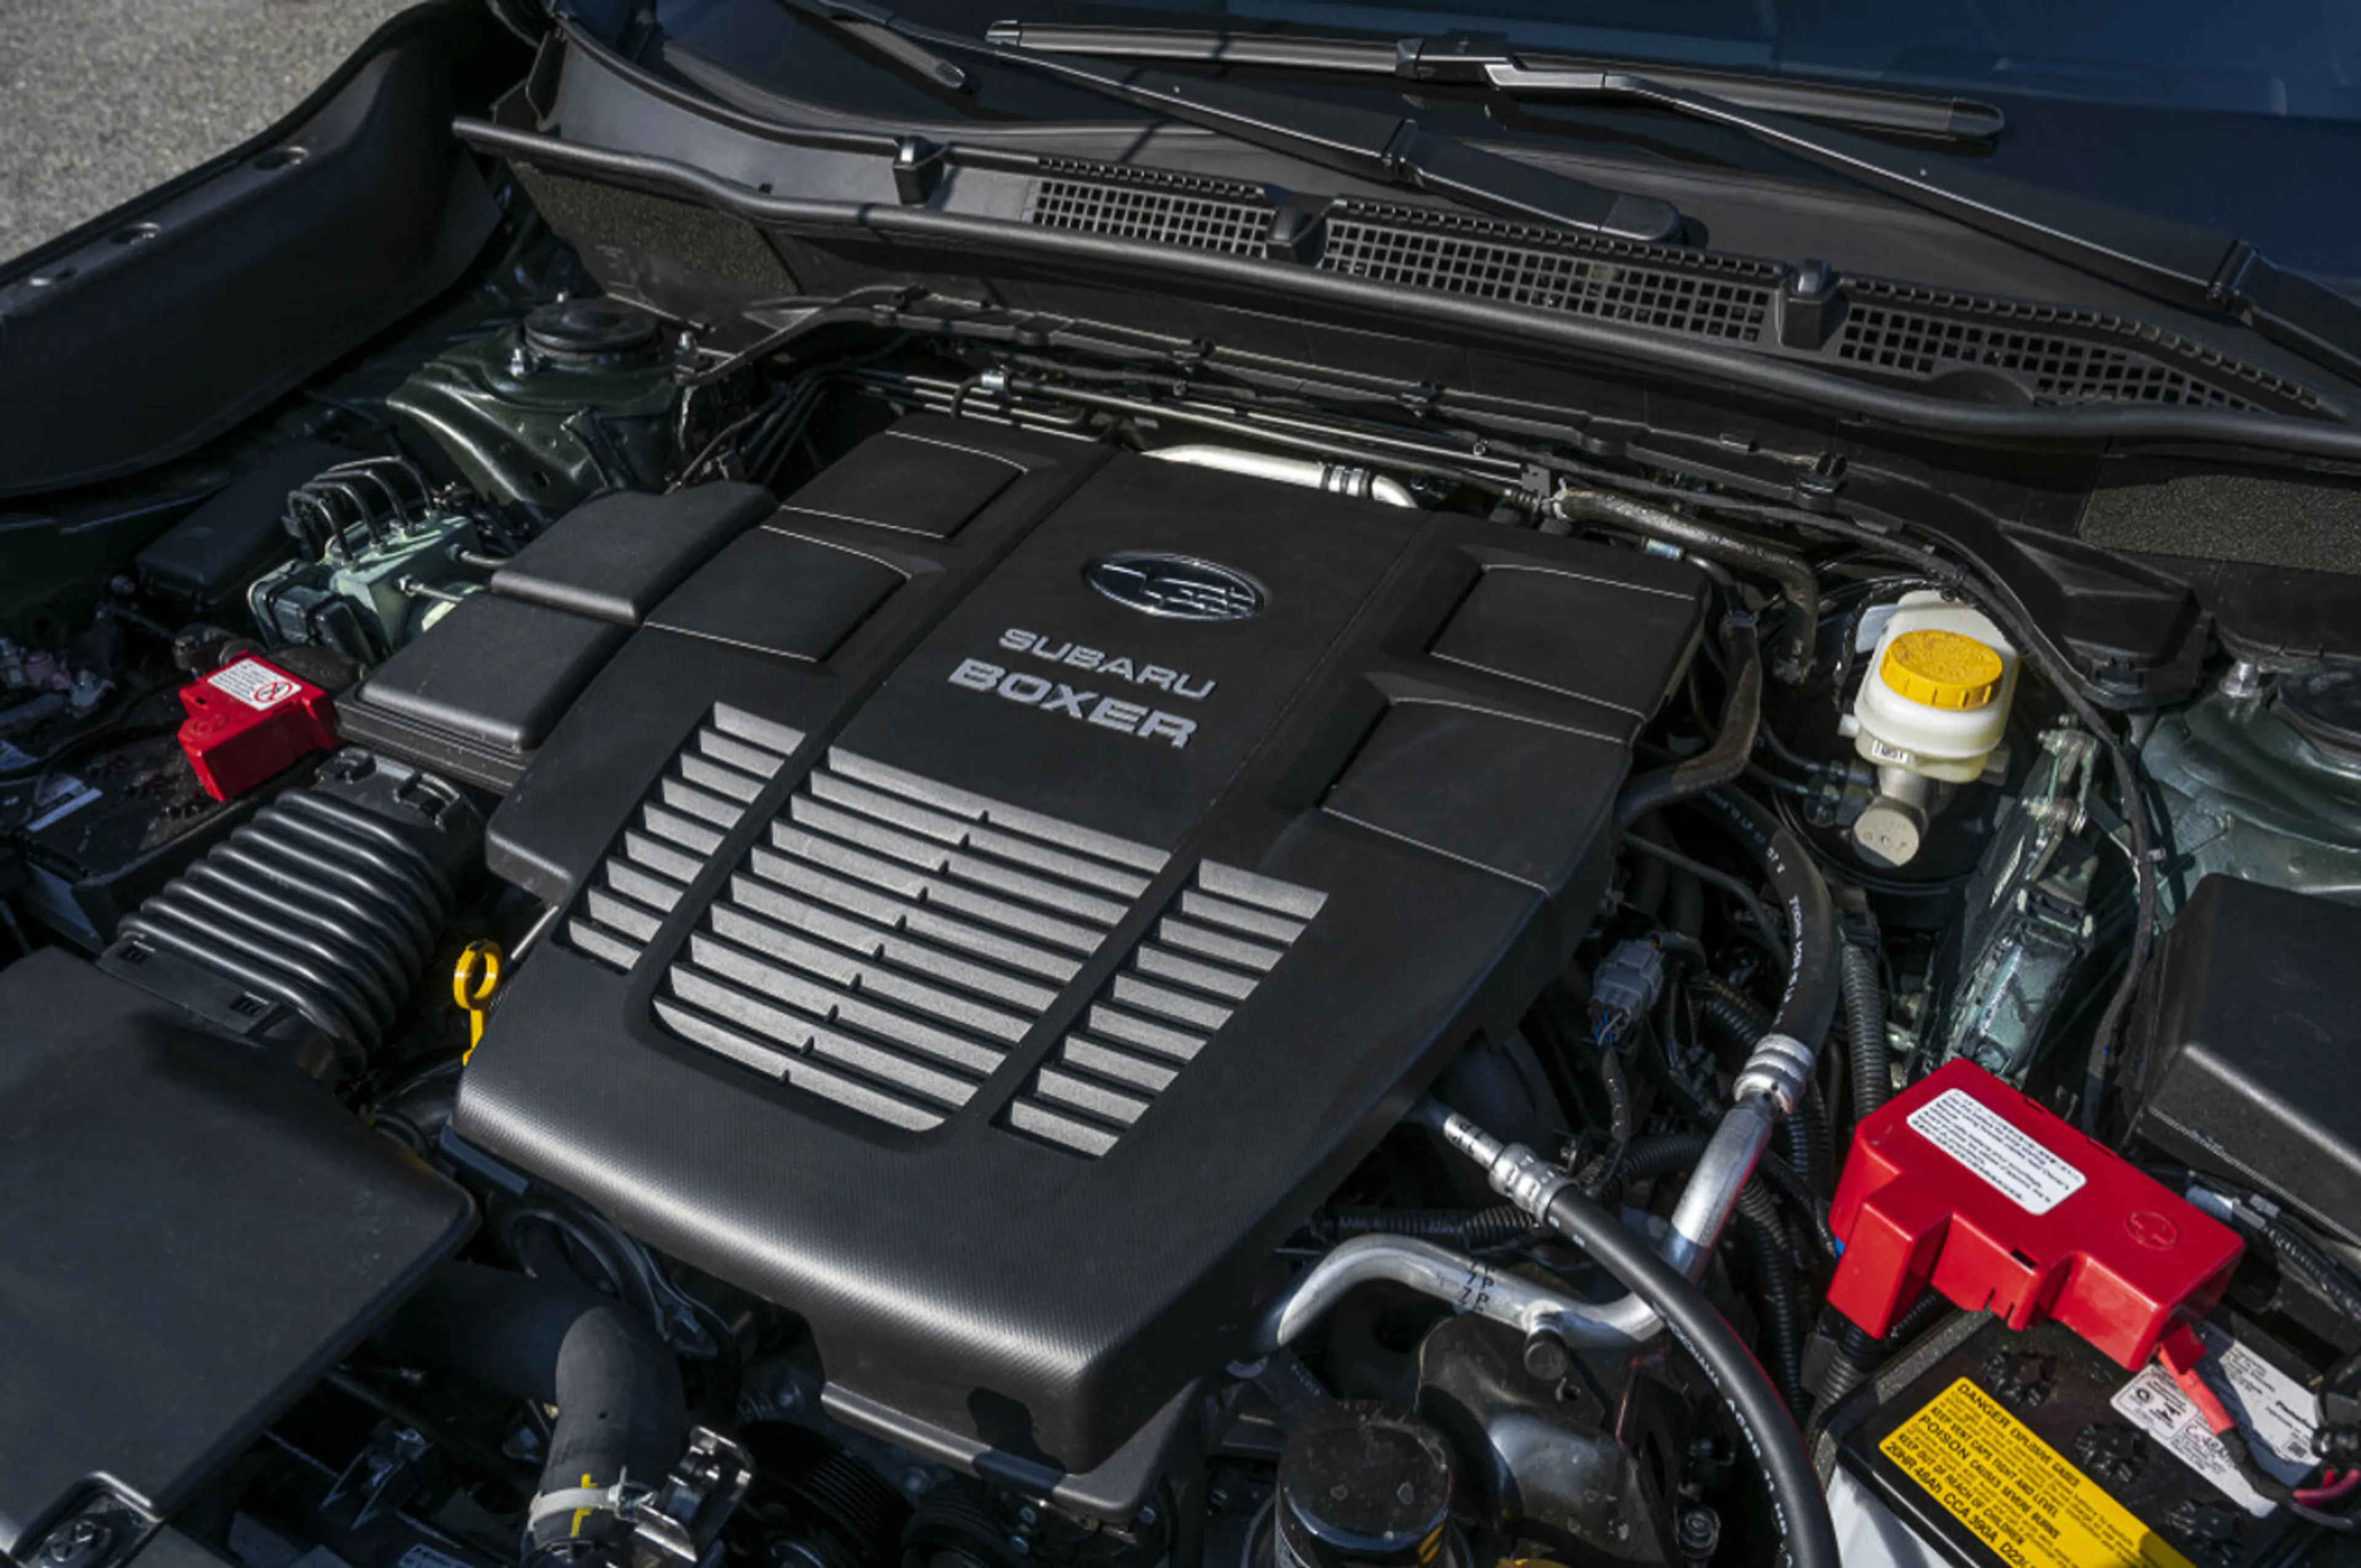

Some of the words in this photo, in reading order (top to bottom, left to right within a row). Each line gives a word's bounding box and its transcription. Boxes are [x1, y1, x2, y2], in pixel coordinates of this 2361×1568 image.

[948, 658, 1199, 748] BOXER
[999, 628, 1217, 700] SUBARU
[1919, 1413, 1972, 1459] POISON
[1969, 1458, 2004, 1488] CAUSES
[2001, 1485, 2033, 1513] SEVERE
[2030, 1511, 2062, 1539] BURNS
[1931, 1405, 1953, 1424] KEEP
[1950, 1422, 1973, 1441] VENT
[1970, 1439, 1995, 1460] CAPS
[1991, 1457, 2018, 1480] TIGHT
[2015, 1477, 2036, 1495] AND
[2032, 1492, 2061, 1517] LEVEL
[1957, 1382, 2012, 1428] DANGER
[2009, 1427, 2054, 1464] EXPLOSIVE
[2051, 1461, 2082, 1486] GASES
[1898, 1431, 1920, 1452] KEEP
[1916, 1448, 1936, 1466] OUT
[1933, 1463, 1947, 1476] OF
[1945, 1473, 1974, 1500] REACH
[1971, 1497, 1984, 1509] OF
[1983, 1507, 2026, 1545] CHILDREN
[1943, 1490, 1973, 1518] CCA
